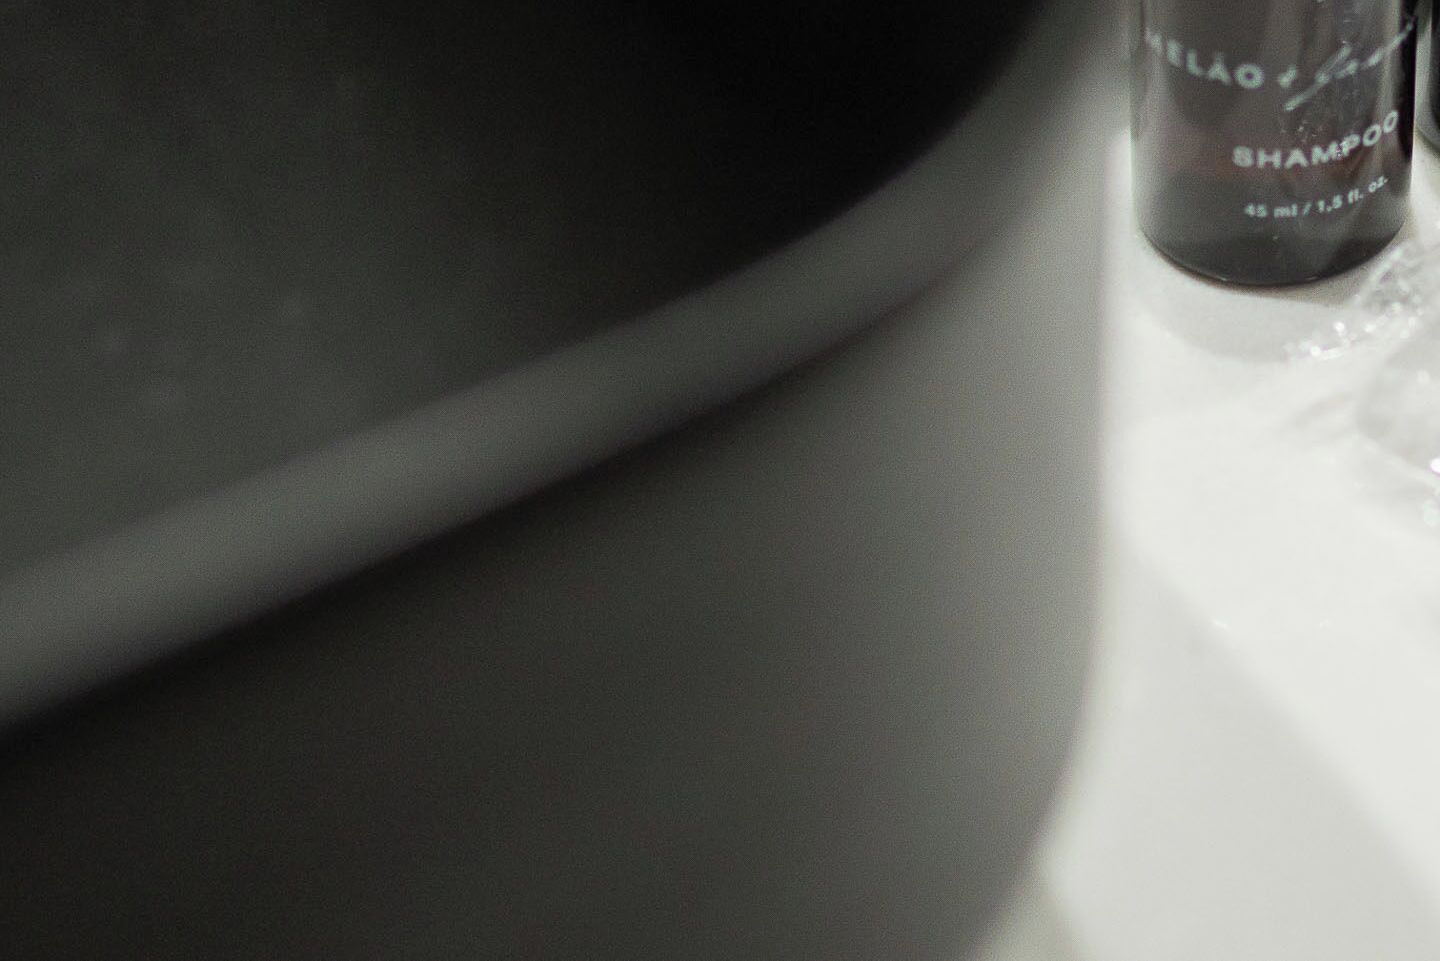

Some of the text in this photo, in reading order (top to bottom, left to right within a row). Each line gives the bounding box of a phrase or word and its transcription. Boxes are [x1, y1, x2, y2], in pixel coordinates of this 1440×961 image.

[1232, 110, 1399, 170] SHAMPOO
[1244, 202, 1268, 219] 45
[1273, 203, 1299, 219] ml
